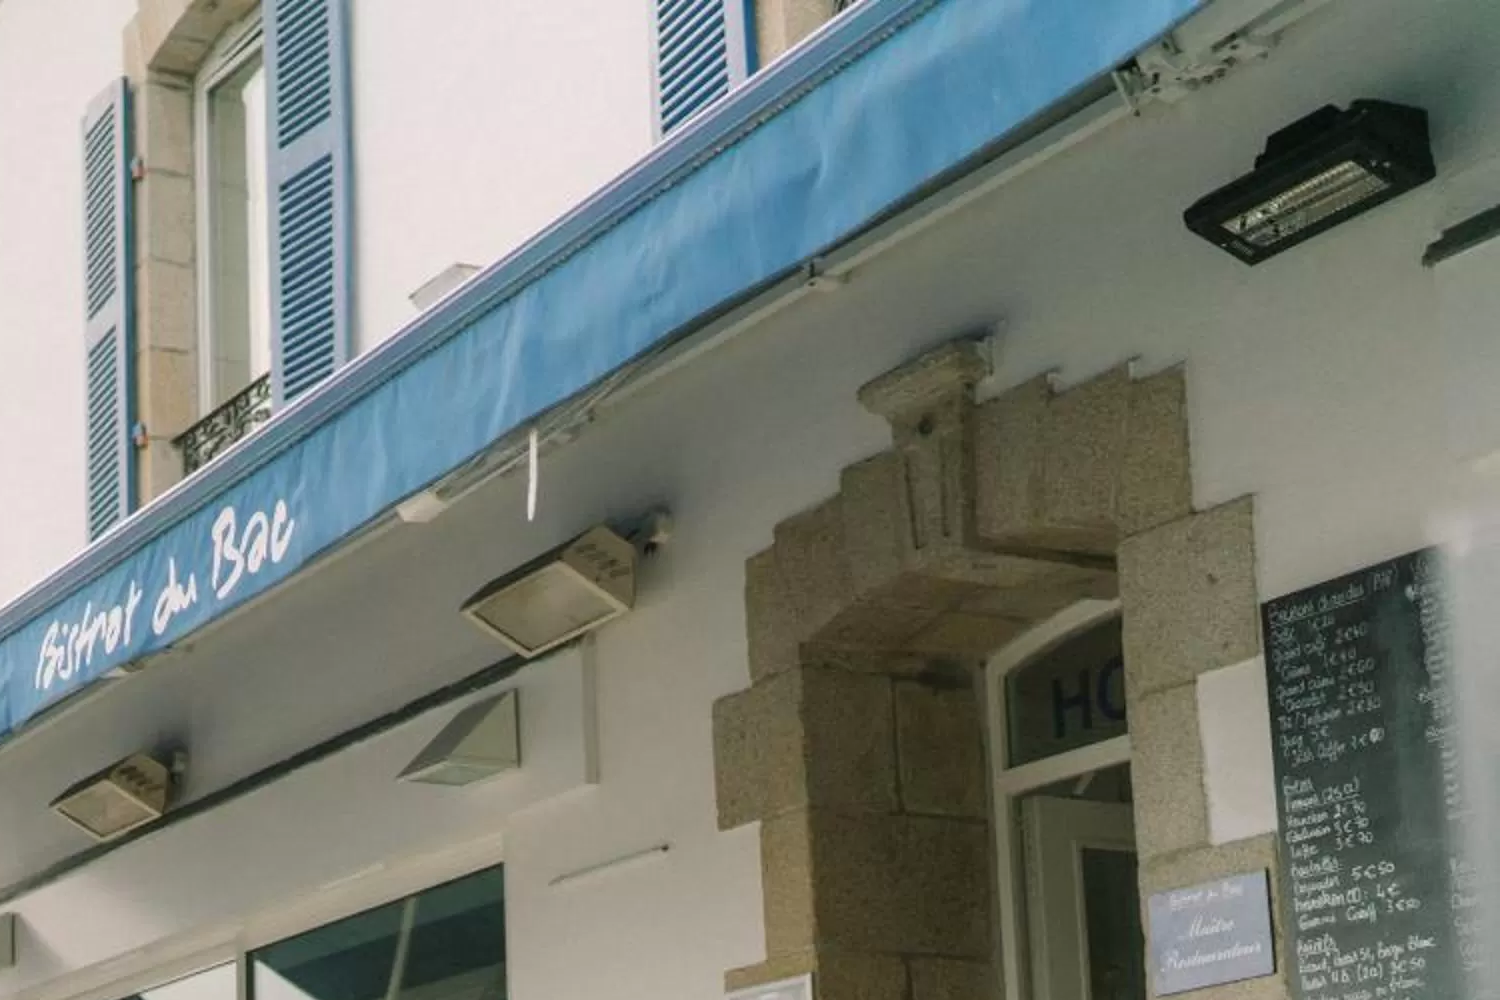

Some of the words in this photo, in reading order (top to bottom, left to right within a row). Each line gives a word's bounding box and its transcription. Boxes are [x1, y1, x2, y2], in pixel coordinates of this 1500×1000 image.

[36, 580, 142, 689] Bistrot
[152, 557, 197, 635] du
[211, 498, 295, 599] Bac
